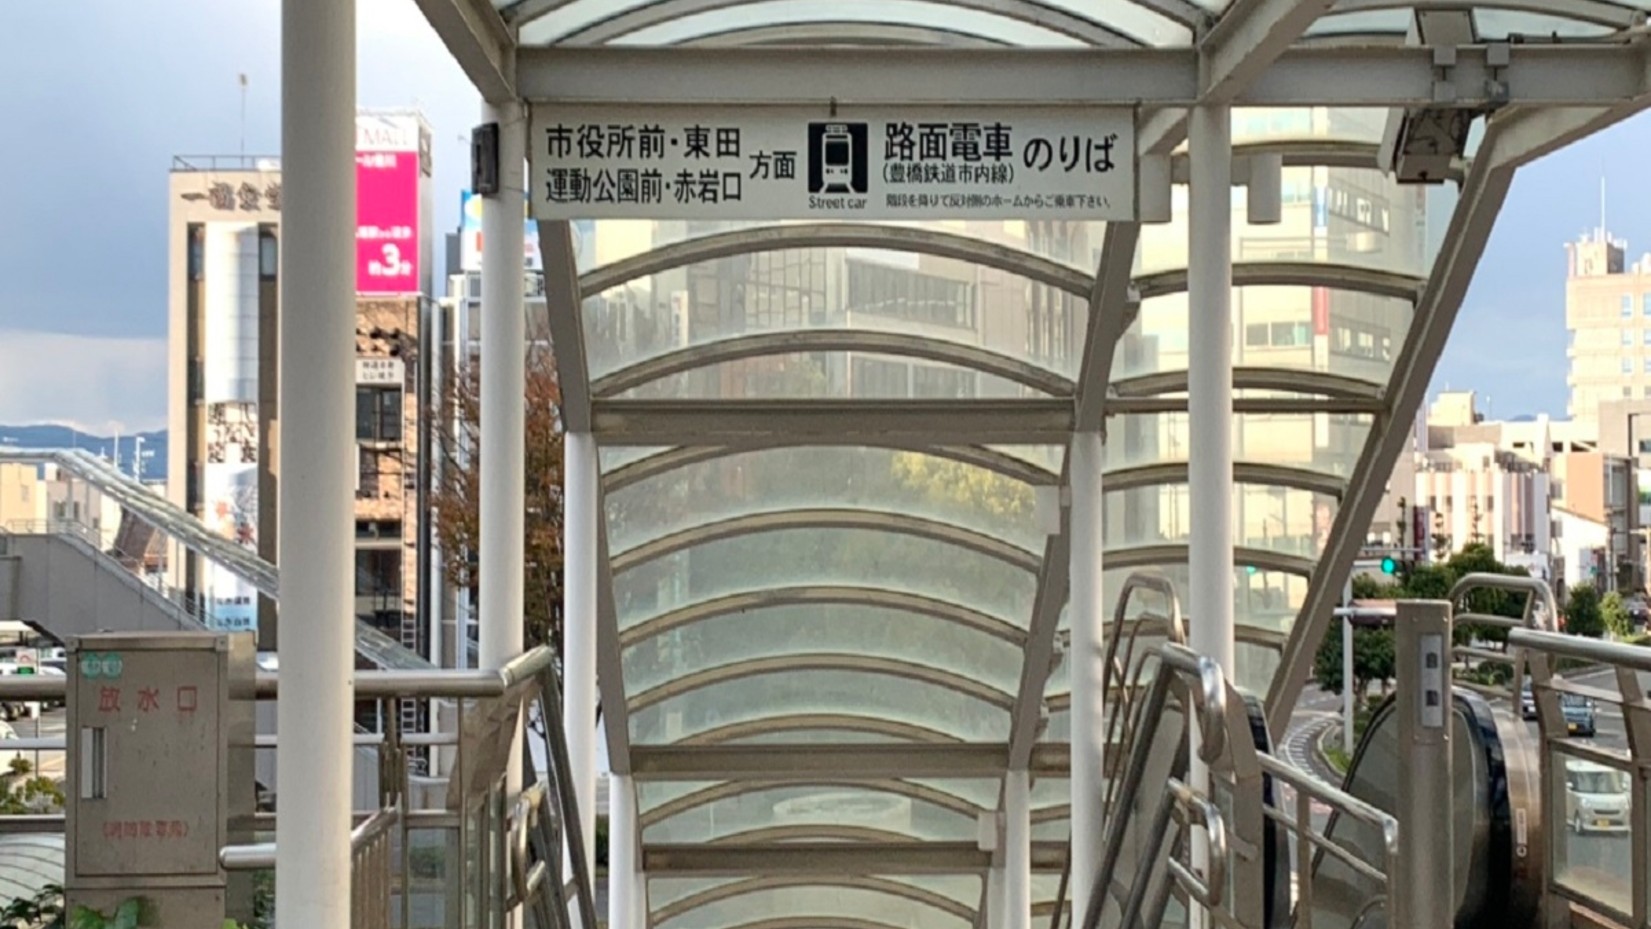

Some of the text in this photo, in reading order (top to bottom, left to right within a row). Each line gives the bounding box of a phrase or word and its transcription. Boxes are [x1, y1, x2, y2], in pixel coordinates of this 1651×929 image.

[545, 124, 741, 159] 市役所前・東田
[884, 122, 1118, 173] 路面電車 のりば
[749, 150, 798, 180] 方面
[546, 168, 742, 204] 運動公園前・赤岩口
[808, 195, 868, 209] Street car
[98, 685, 198, 712] 放水口
